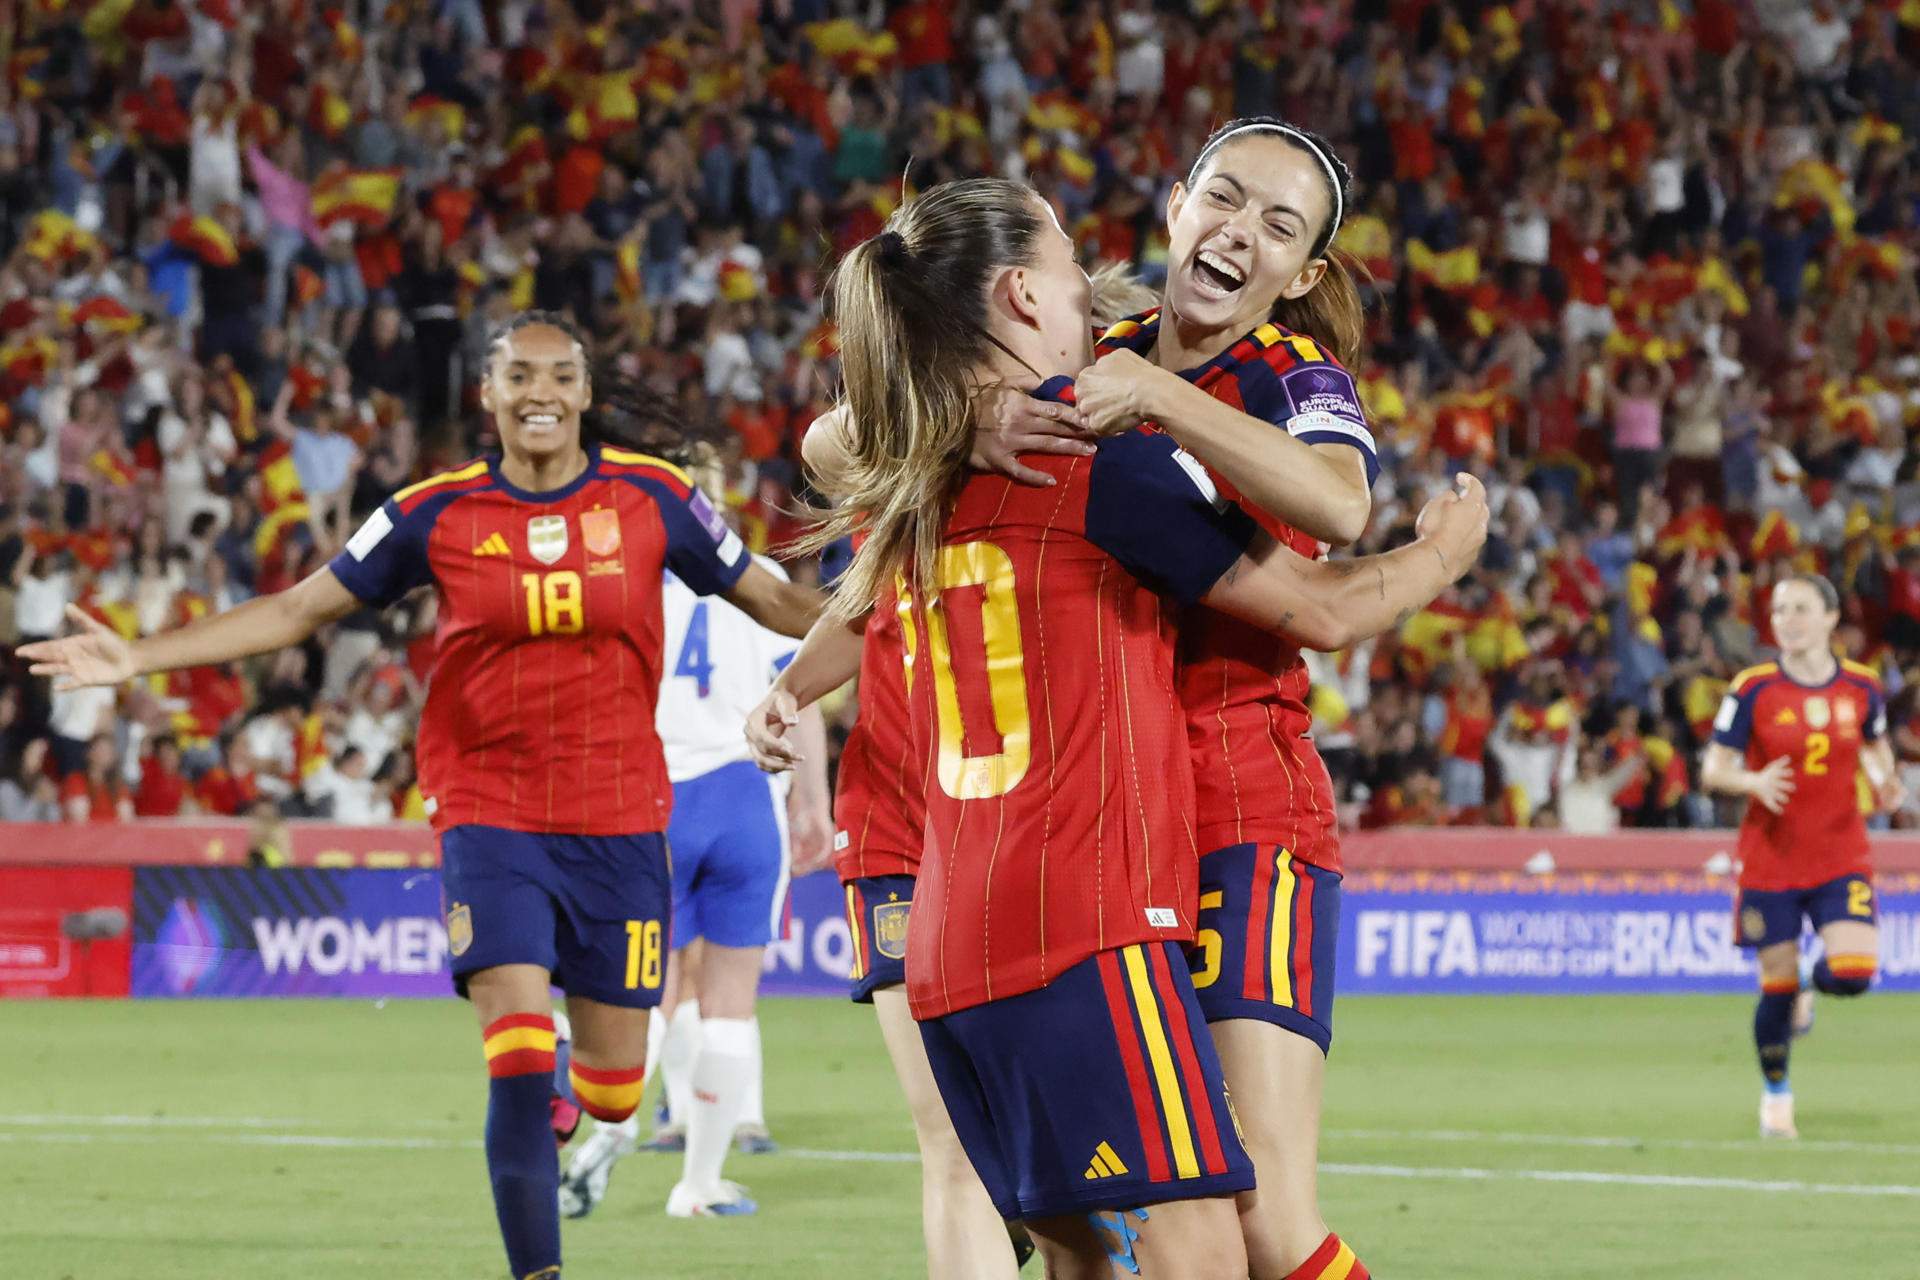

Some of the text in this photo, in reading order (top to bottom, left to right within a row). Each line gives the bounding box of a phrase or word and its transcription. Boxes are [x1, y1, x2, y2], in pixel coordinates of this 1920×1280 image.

[1300, 397, 1357, 411] EUROPEAN
[1300, 403, 1360, 417] QUALIFIERS
[522, 570, 584, 635] 18
[674, 602, 717, 698] 4
[1804, 733, 1830, 776] 2
[1847, 881, 1872, 917] 2
[625, 920, 662, 989] 18
[1356, 911, 1478, 976] FIFA
